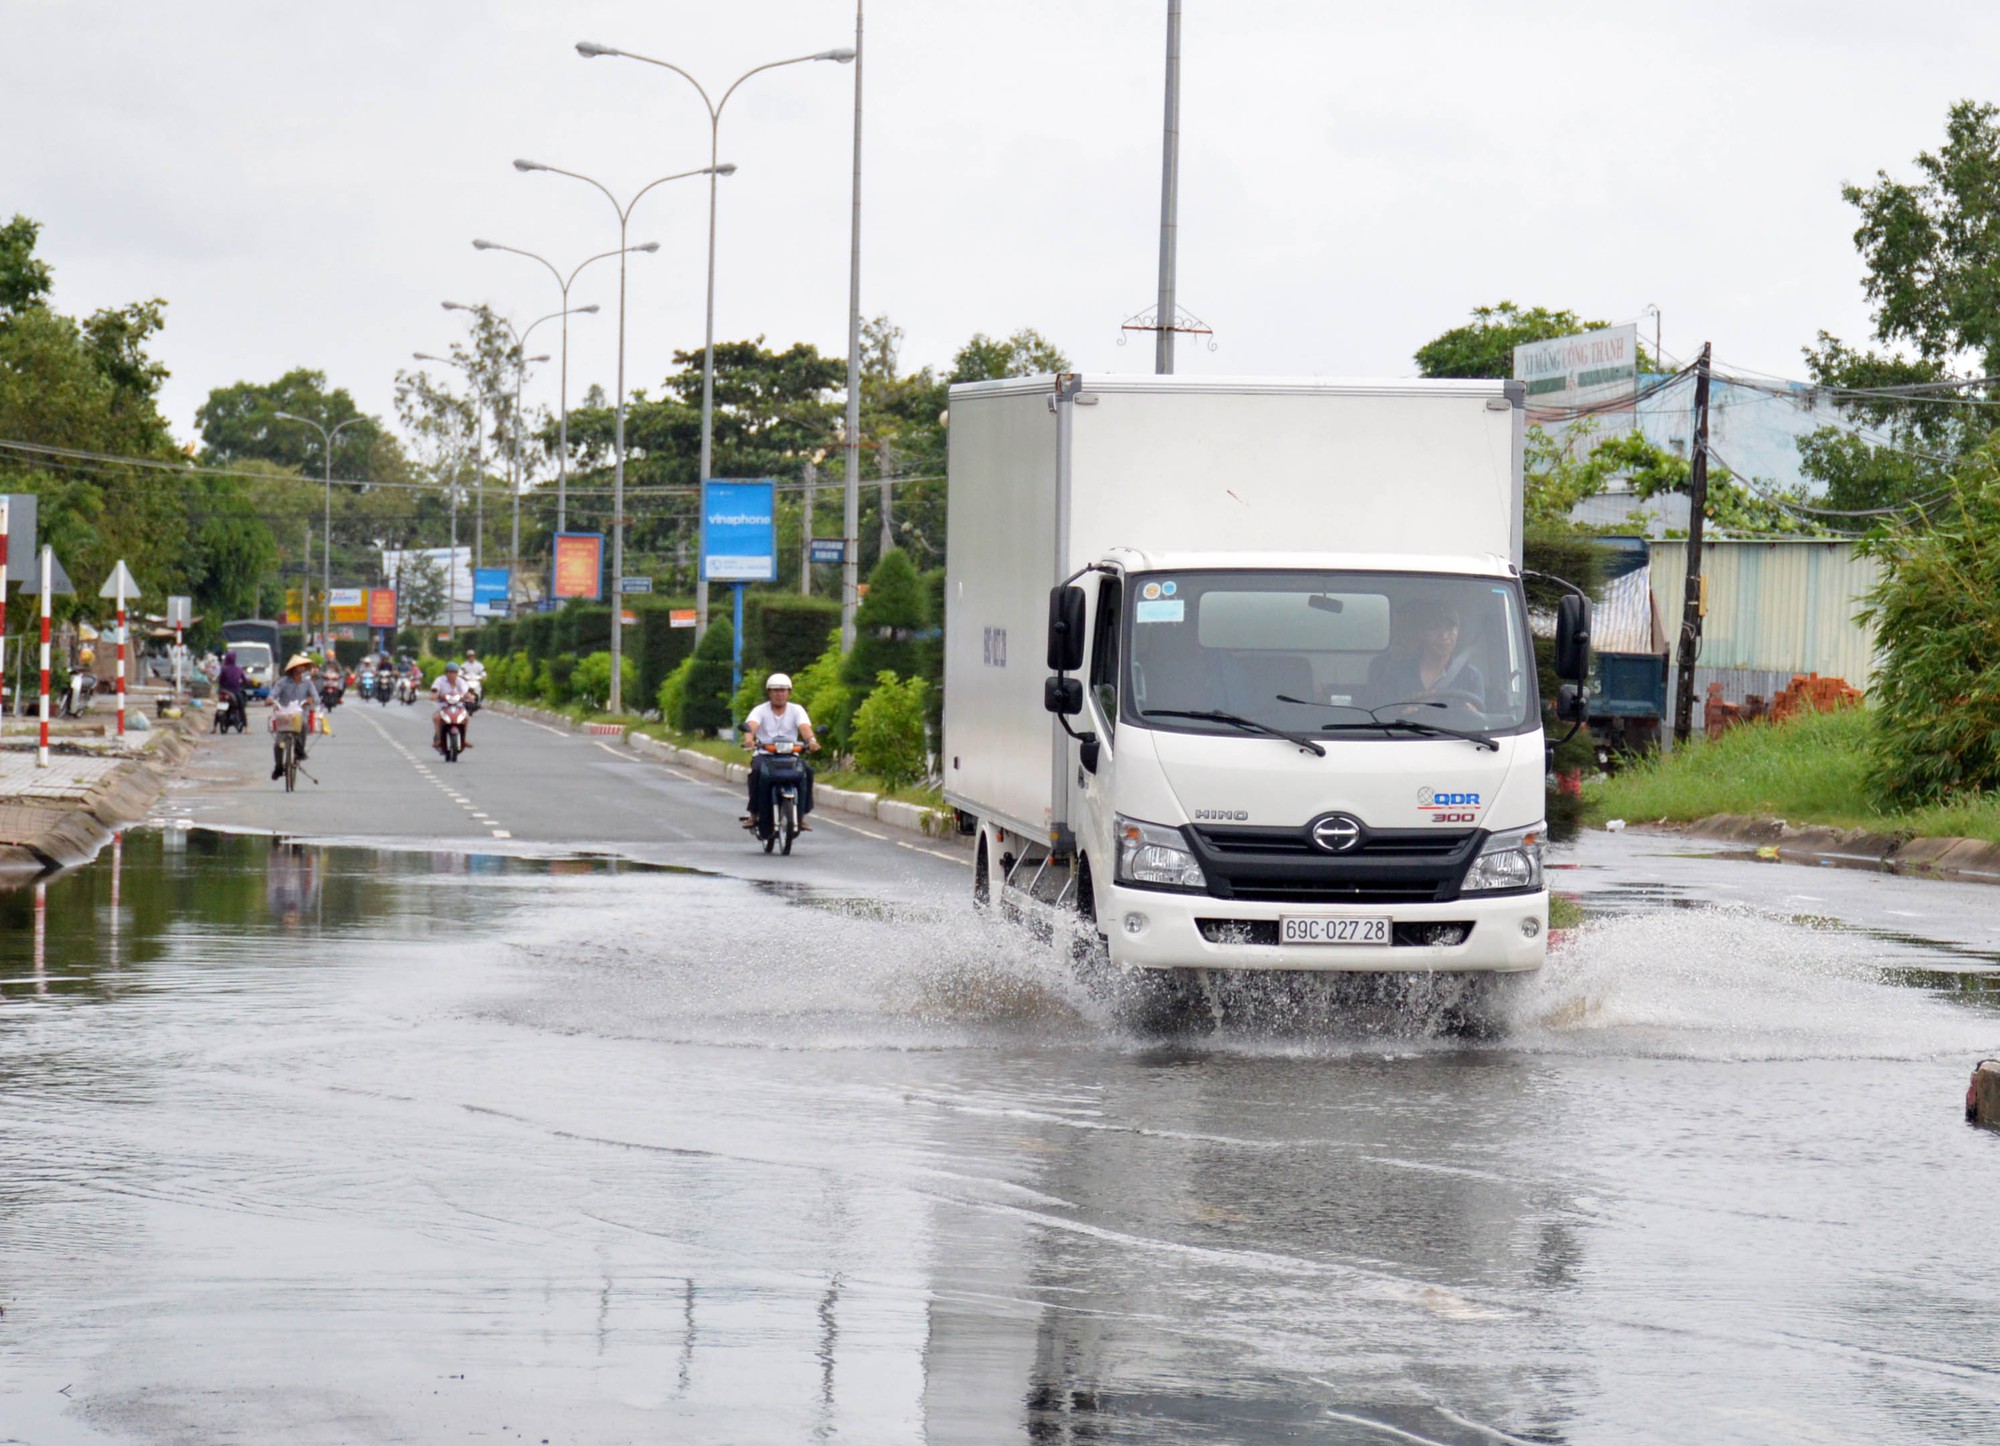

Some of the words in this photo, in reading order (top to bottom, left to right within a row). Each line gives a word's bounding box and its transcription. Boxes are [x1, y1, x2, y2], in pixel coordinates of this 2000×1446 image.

[708, 513, 771, 526] vinaphone
[1434, 793, 1480, 805] QDR
[1195, 809, 1249, 821] HINO
[1432, 813, 1475, 823] 300
